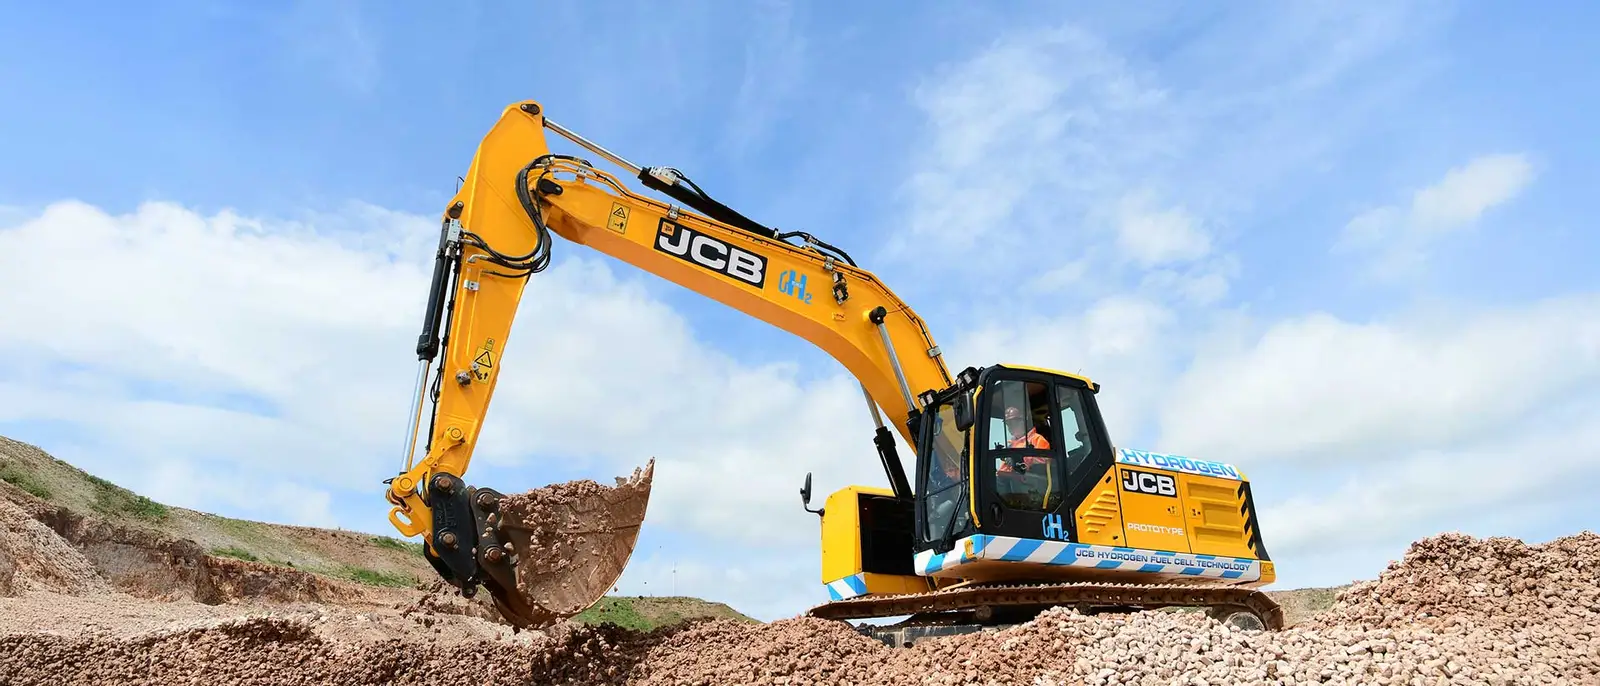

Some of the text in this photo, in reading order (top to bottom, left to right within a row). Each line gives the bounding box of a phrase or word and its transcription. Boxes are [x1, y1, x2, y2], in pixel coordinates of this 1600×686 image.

[658, 228, 764, 284] JCB
[1120, 448, 1238, 478] HYDROGEN
[1123, 472, 1176, 496] JCB
[1127, 522, 1184, 536] PROTOTYPE
[1076, 549, 1251, 571] JCB HYDROGEN FUEL CELL TECHNOLOGY
